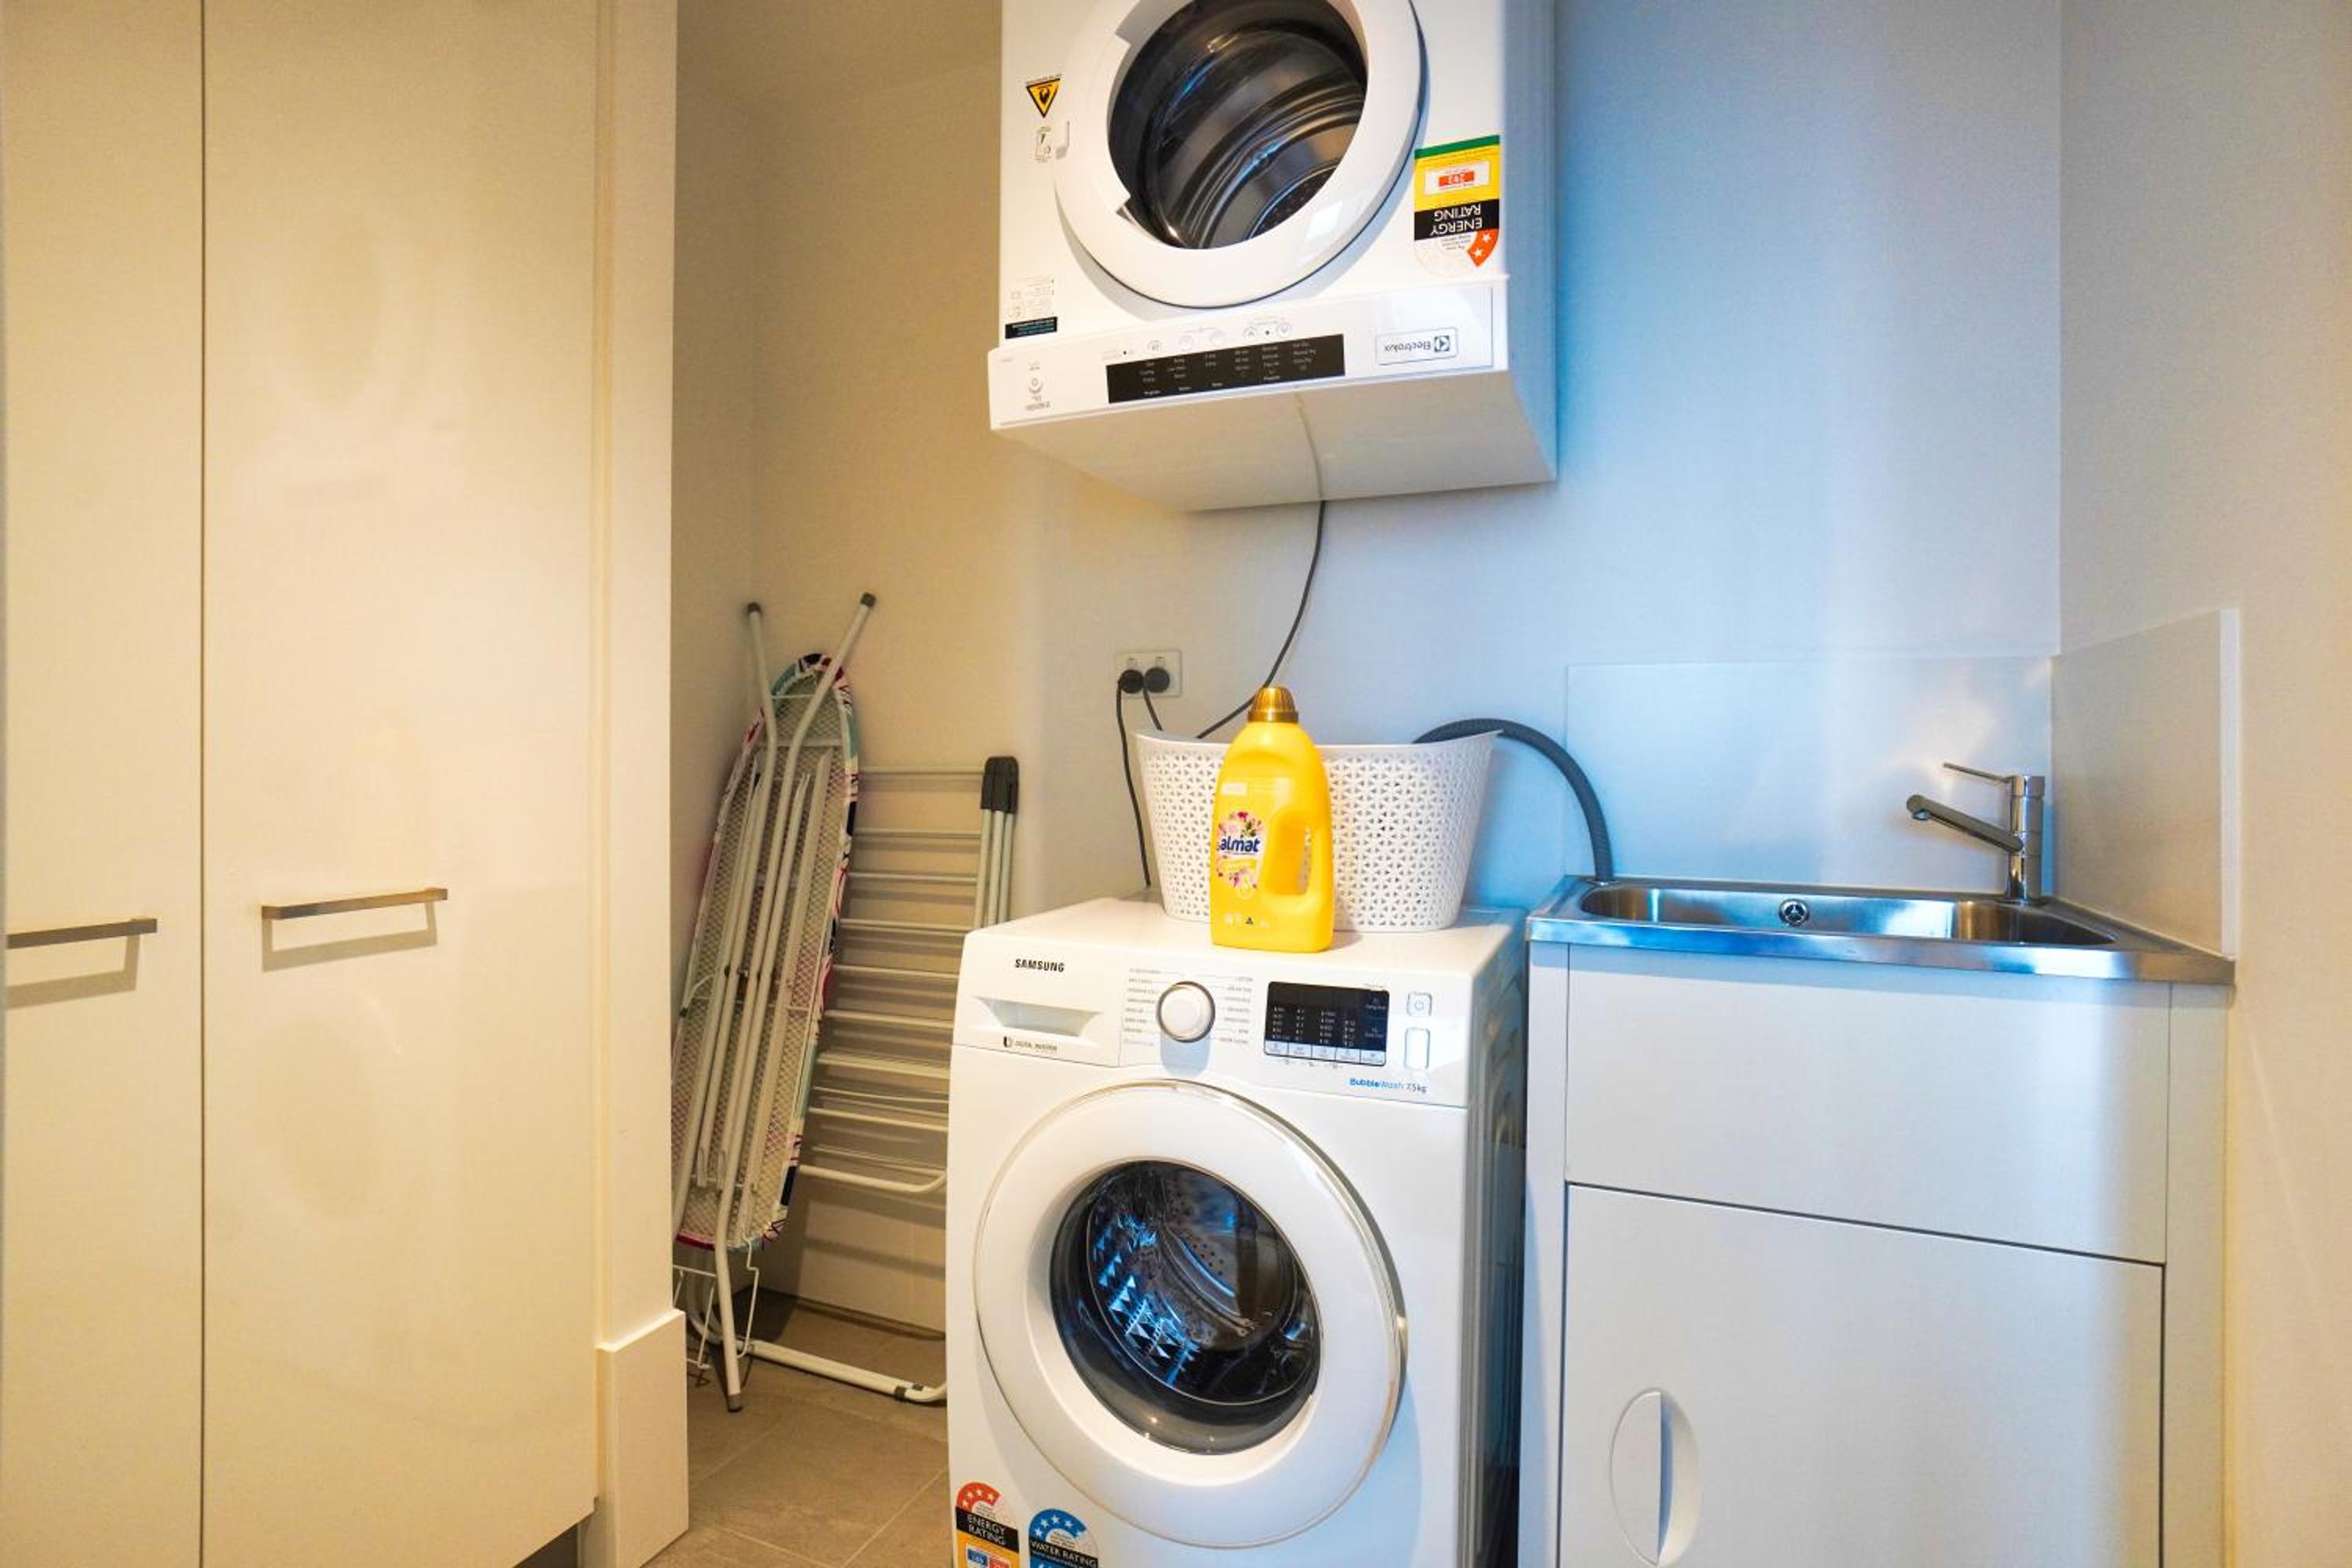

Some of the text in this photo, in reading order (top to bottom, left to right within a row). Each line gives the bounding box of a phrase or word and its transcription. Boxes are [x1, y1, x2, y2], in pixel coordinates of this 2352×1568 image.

[1434, 203, 1481, 221] RATING
[1429, 217, 1483, 235] ENERGY
[1384, 340, 1431, 352] Electrolux
[1220, 836, 1261, 852] almat
[1014, 958, 1065, 972] SAMSUNG
[967, 1515, 1006, 1534] ENERGY
[968, 1525, 1006, 1546] RATING
[1030, 1540, 1062, 1557] WATER
[1062, 1549, 1098, 1567] RATING
